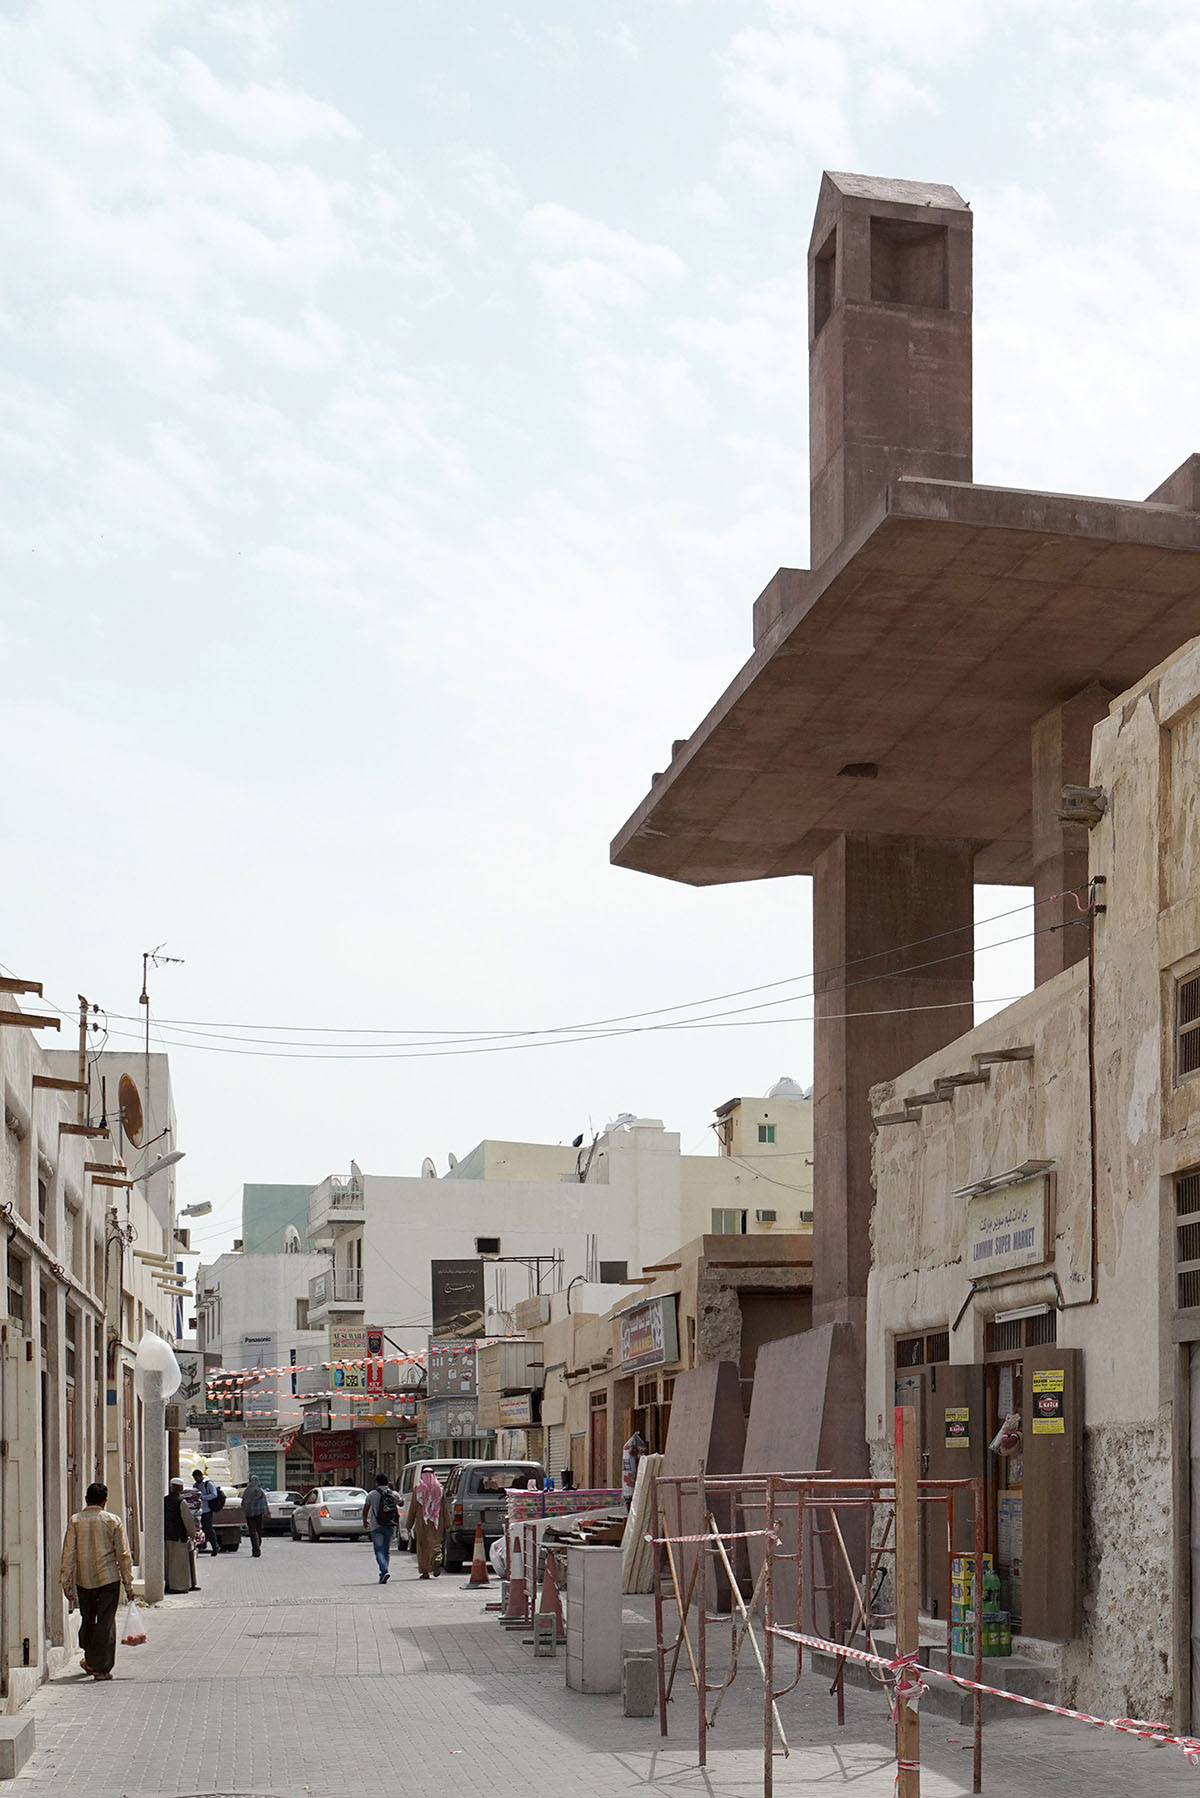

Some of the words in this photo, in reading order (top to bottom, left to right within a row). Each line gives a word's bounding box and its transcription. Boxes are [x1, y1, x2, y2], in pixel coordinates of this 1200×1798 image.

[995, 1233, 1011, 1255] SUPER
[1013, 1227, 1035, 1251] MARKET
[245, 1335, 272, 1343] Panasonic
[1038, 1401, 1059, 1409] Lulu
[315, 1440, 353, 1449] PHOTOCOPY
